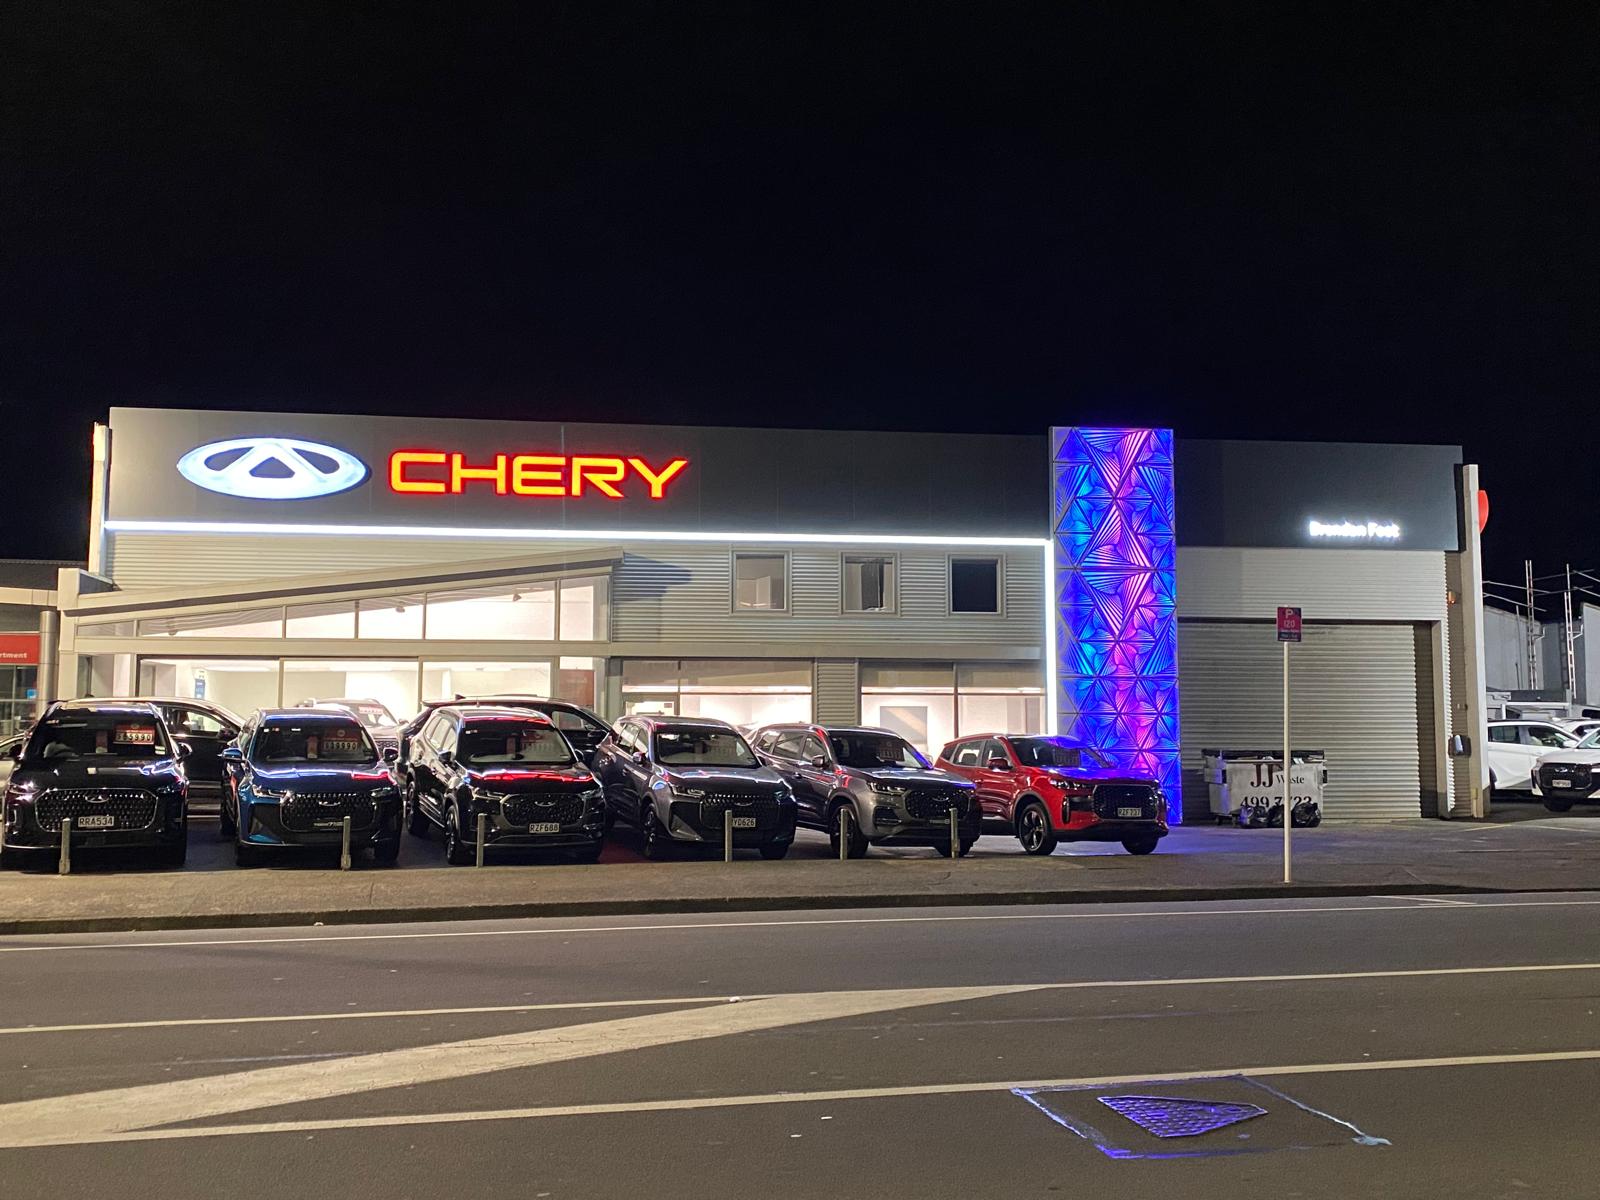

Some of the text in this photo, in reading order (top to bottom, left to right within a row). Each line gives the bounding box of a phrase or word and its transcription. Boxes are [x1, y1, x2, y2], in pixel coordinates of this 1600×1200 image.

[390, 450, 688, 499] CHERY
[1285, 608, 1294, 619] P
[1284, 619, 1296, 629] 120
[1250, 763, 1305, 788] JJ Wste
[79, 817, 113, 826] RRA534
